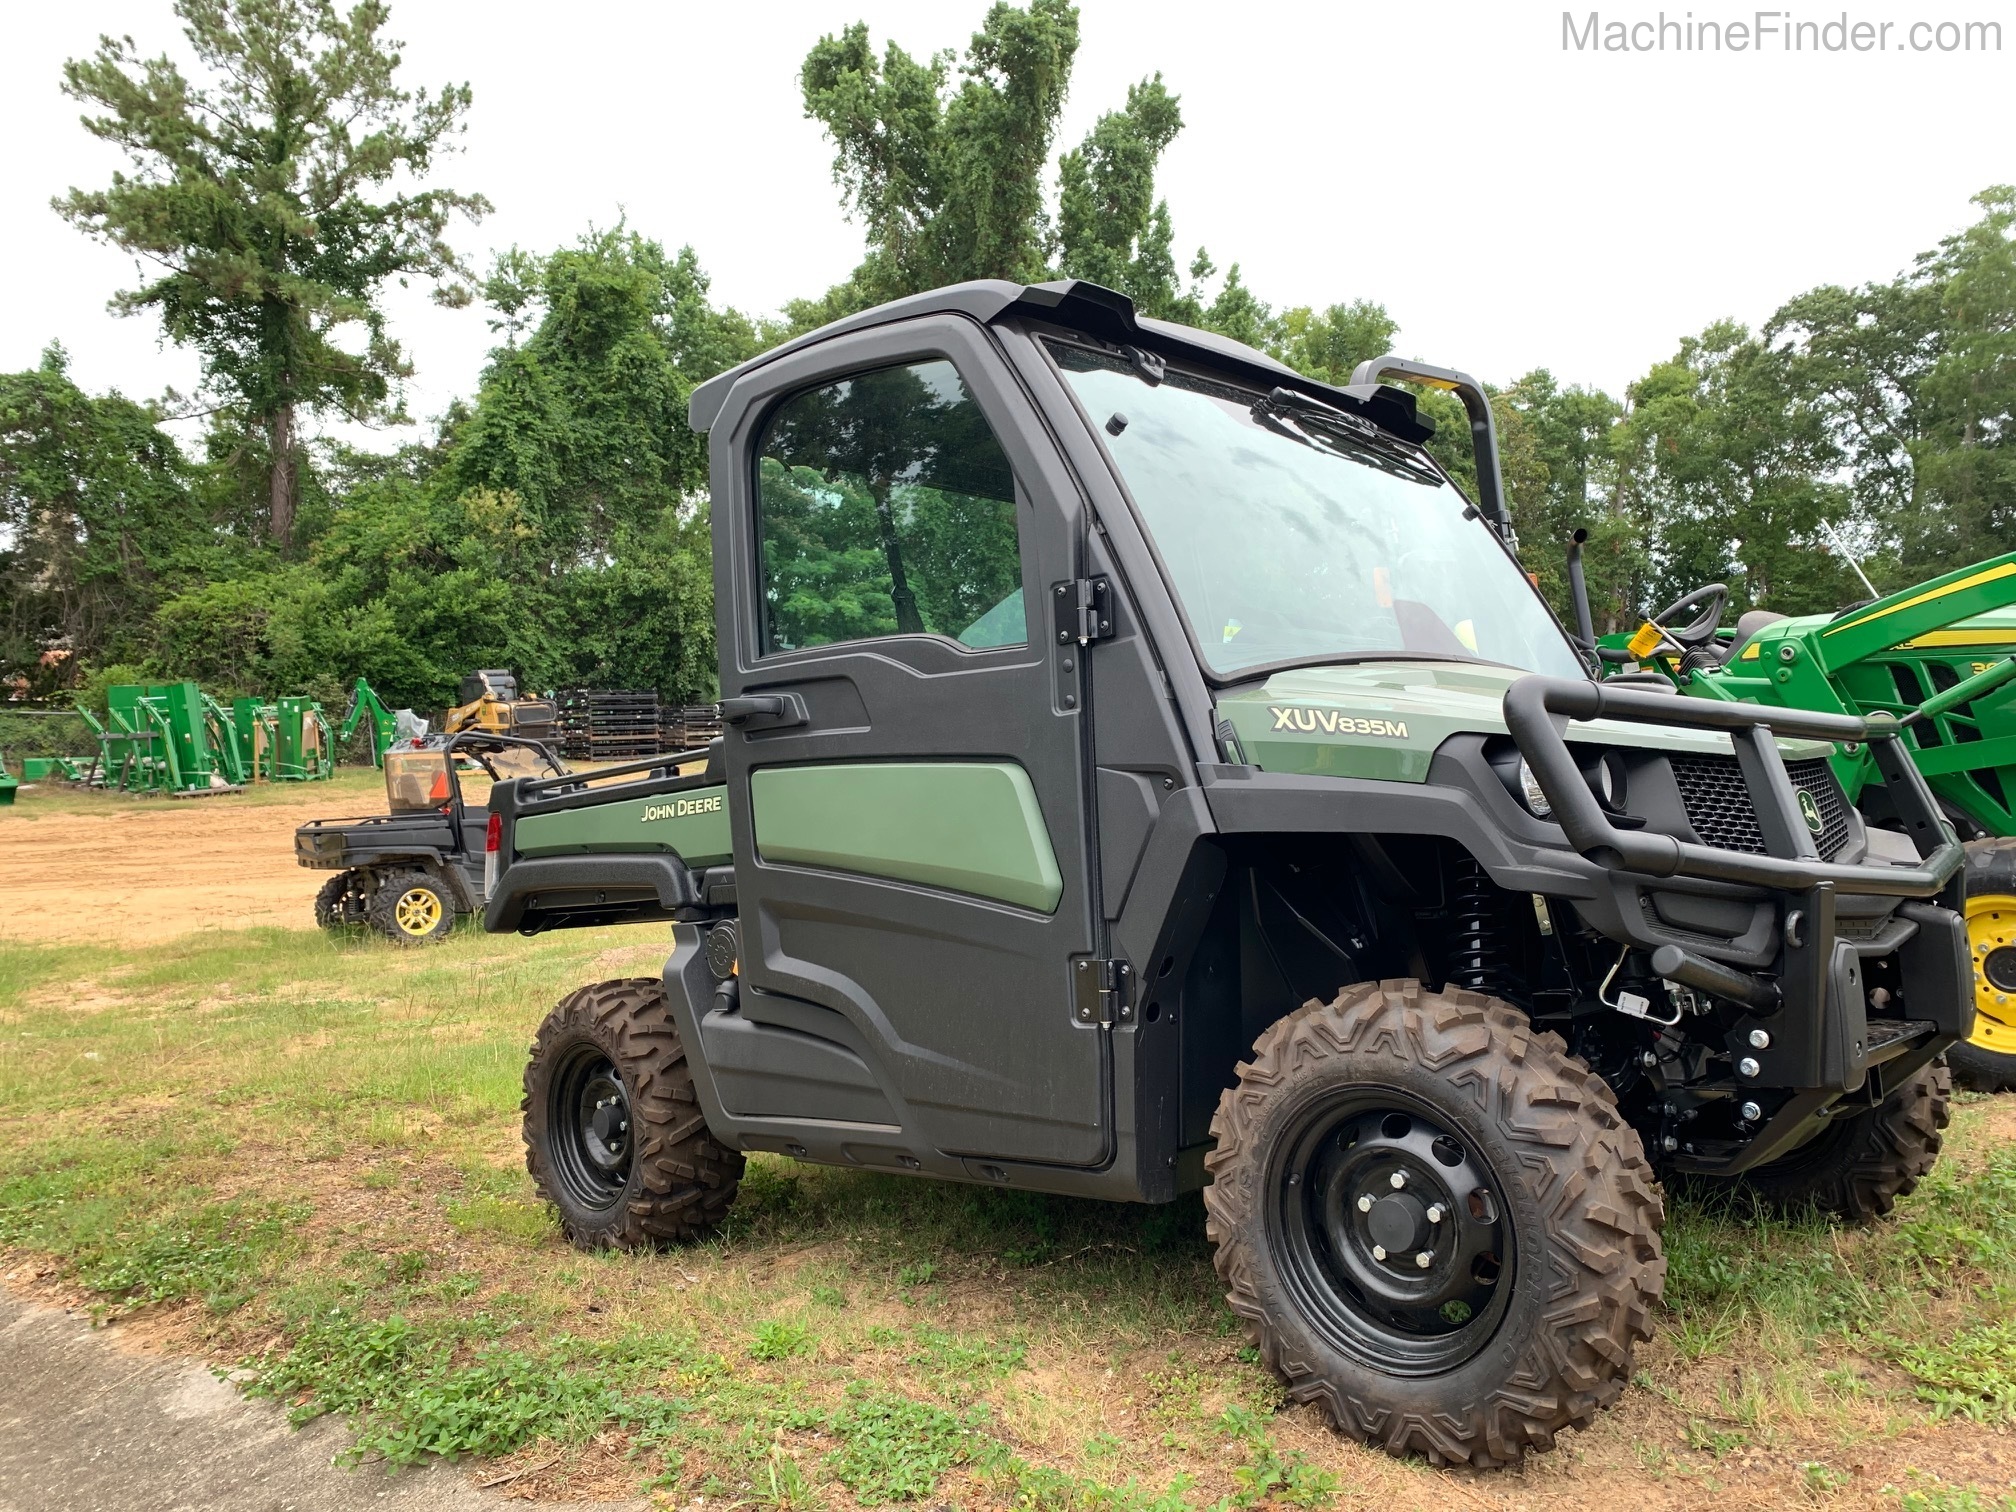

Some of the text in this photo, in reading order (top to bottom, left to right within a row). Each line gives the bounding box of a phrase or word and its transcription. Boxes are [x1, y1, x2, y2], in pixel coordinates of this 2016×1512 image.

[1267, 706, 1409, 739] XUV835M
[641, 795, 722, 823] JOHN DEERE
